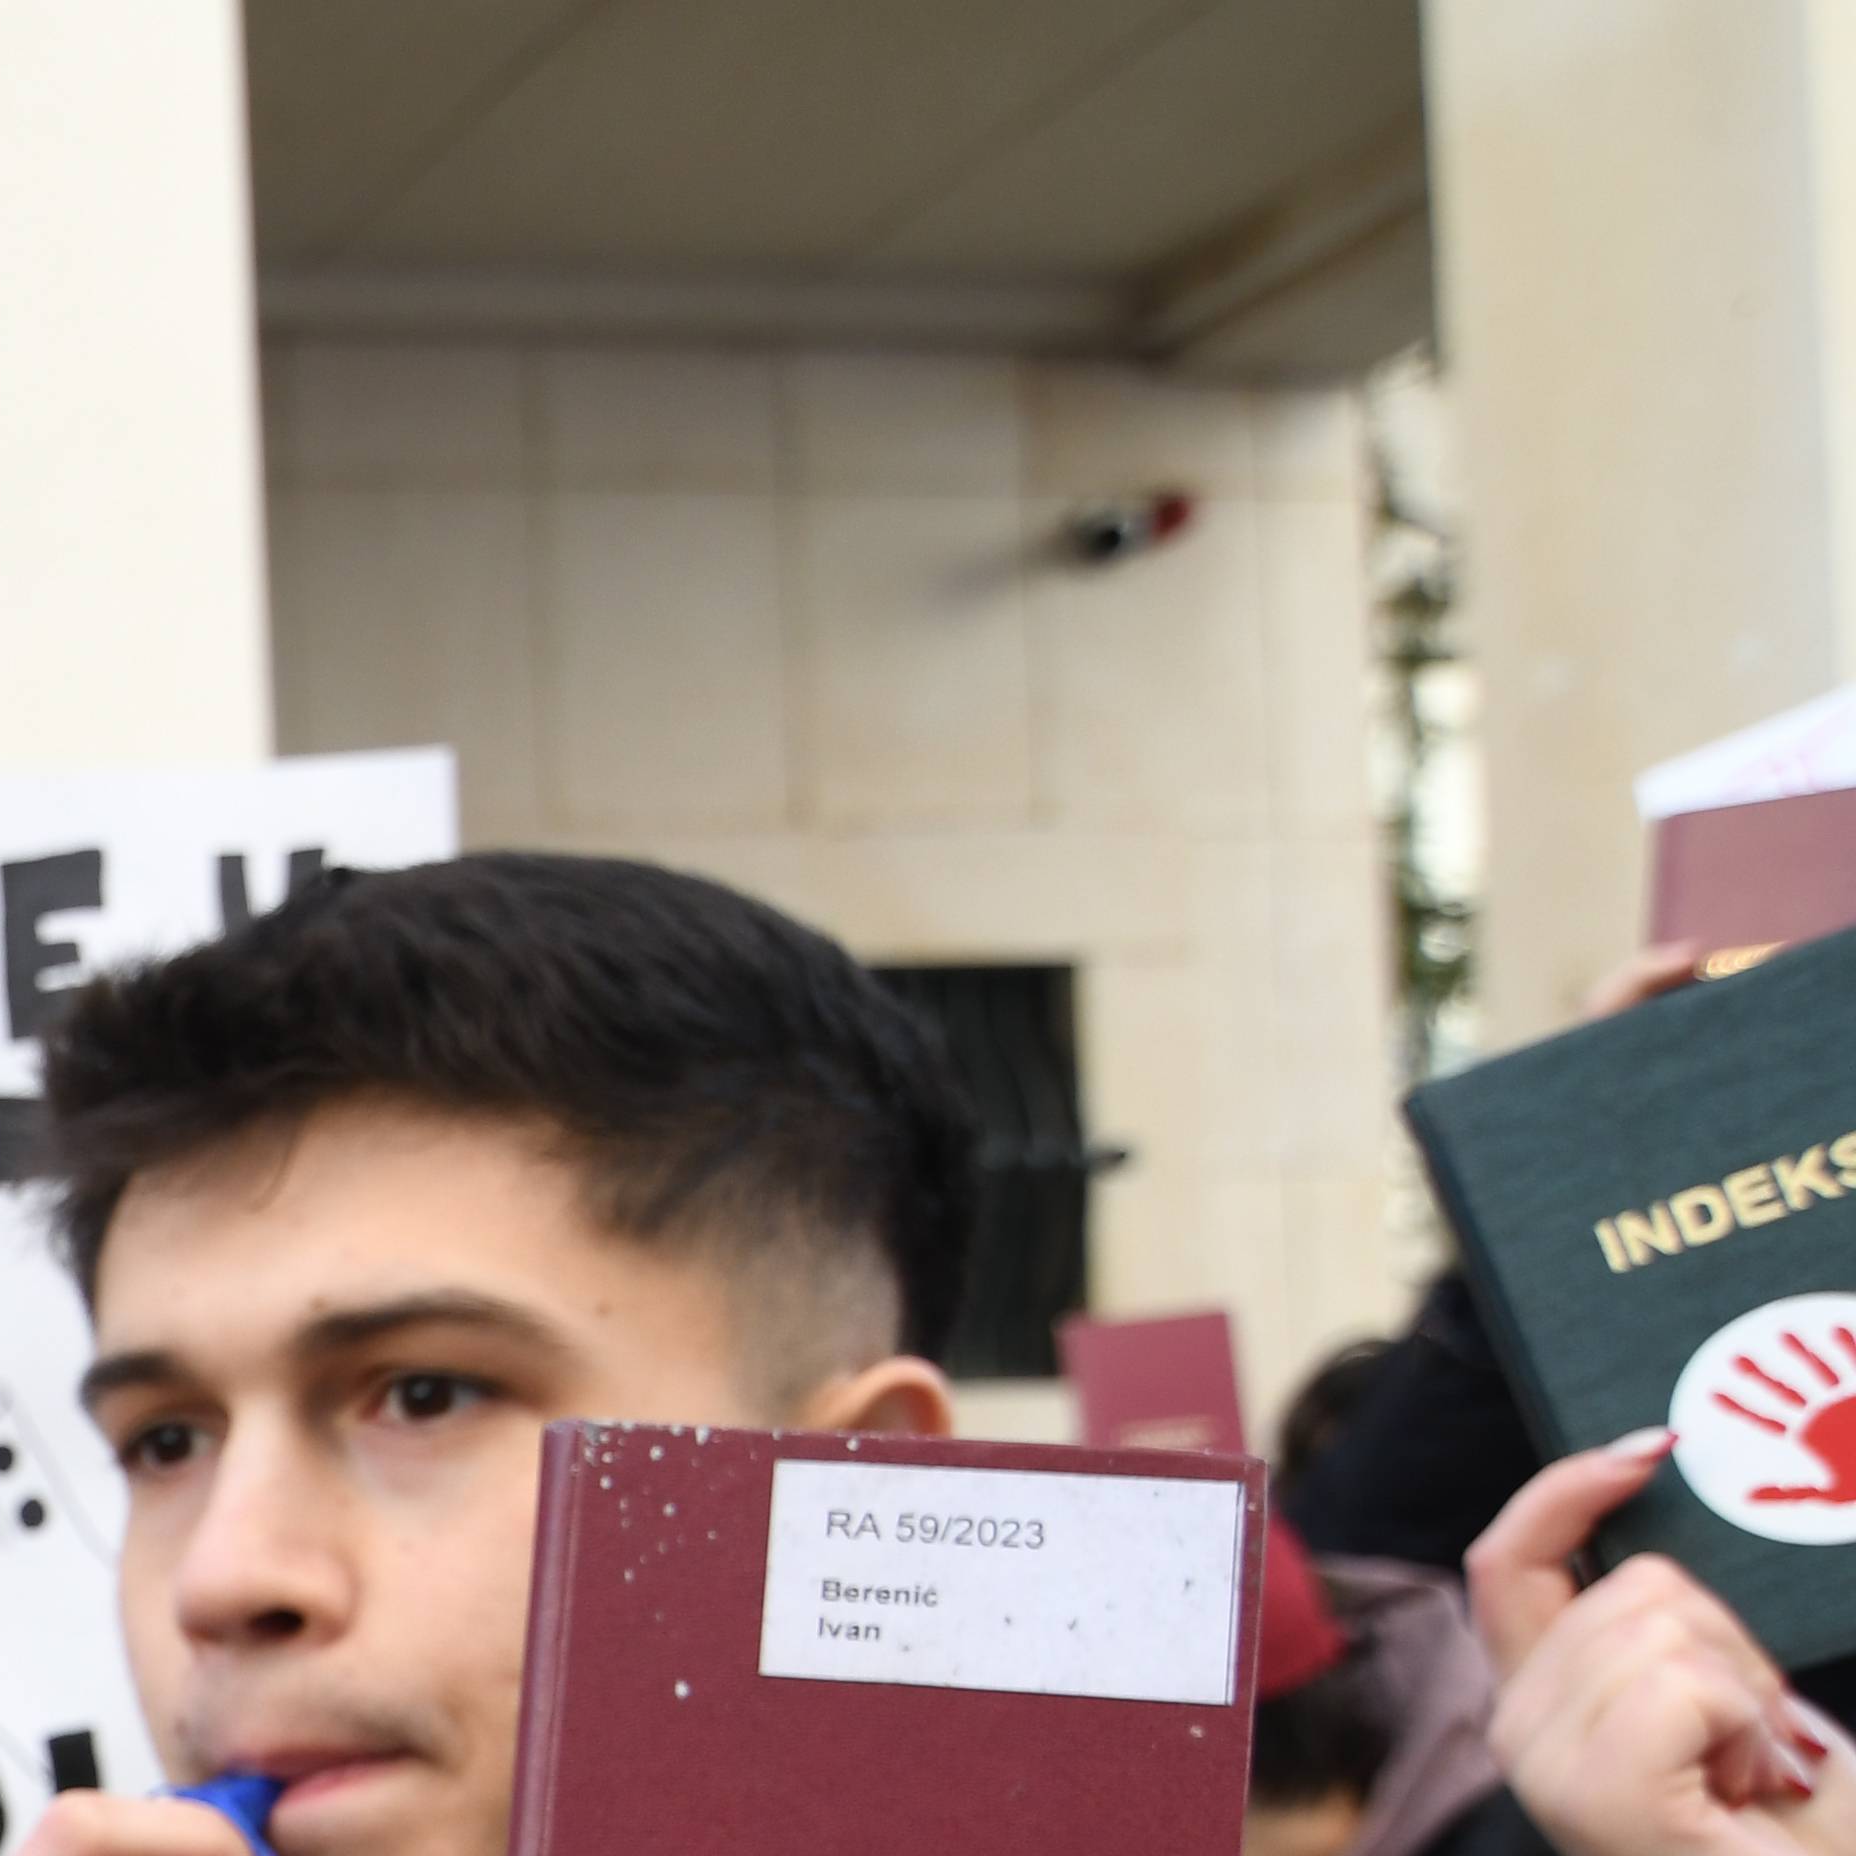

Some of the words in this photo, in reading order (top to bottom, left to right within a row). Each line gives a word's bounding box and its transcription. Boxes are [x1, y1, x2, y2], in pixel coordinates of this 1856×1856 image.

[824, 1508, 882, 1542] RA
[894, 1512, 1046, 1551] 59/2023
[817, 1616, 882, 1641] Ivan
